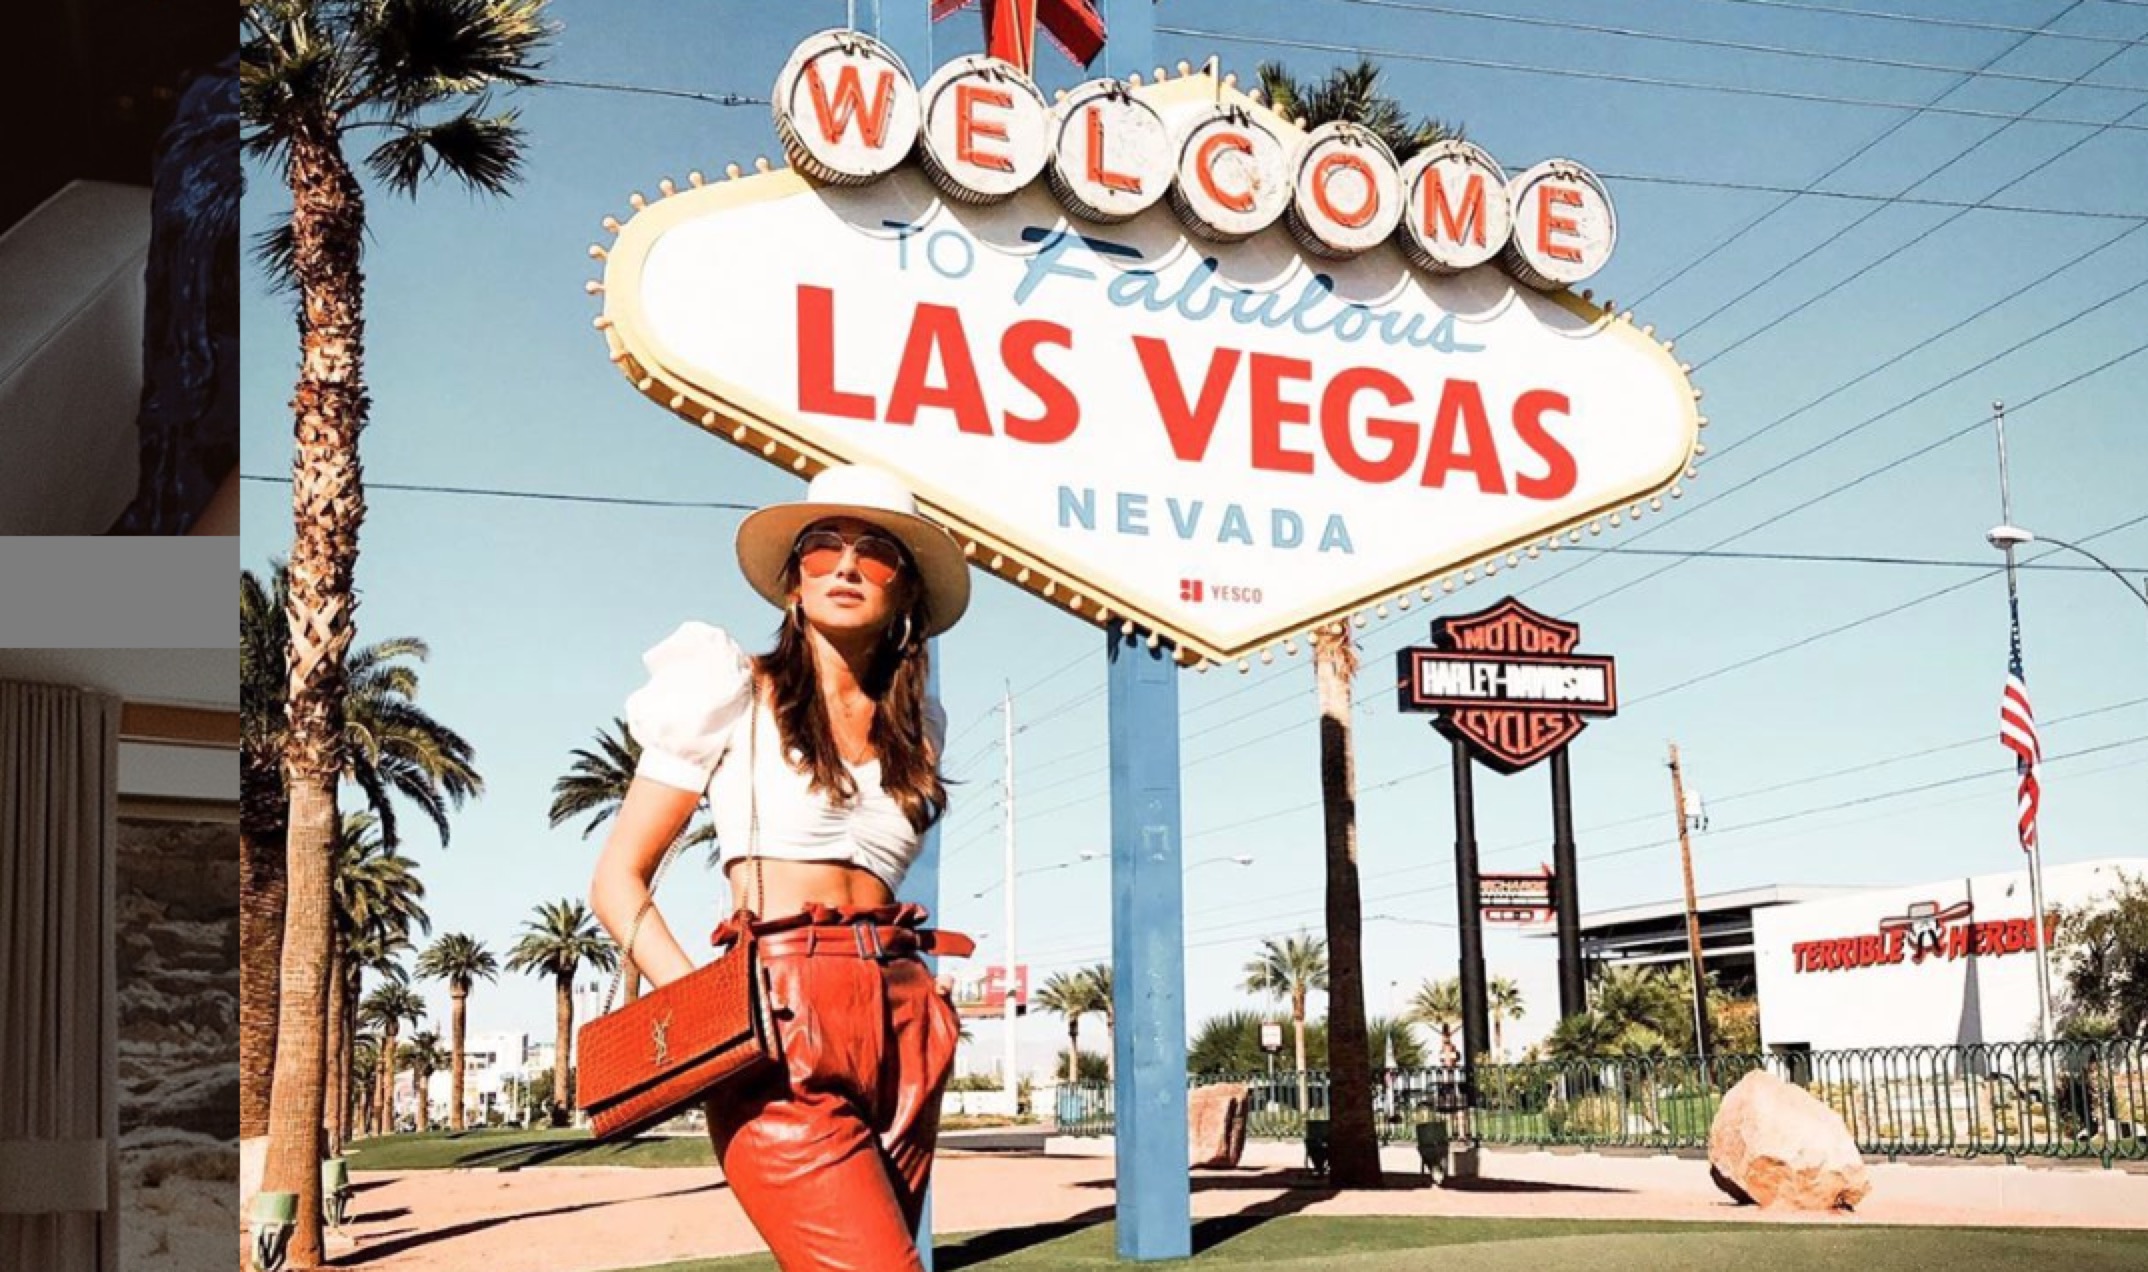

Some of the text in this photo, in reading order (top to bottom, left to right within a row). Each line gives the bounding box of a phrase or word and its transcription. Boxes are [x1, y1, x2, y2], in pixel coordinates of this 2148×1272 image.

[804, 60, 1584, 263] WELCOME
[882, 218, 1487, 353] TO Fabulous
[797, 283, 1579, 501] LAS VEGAS
[1057, 485, 1355, 555] NEVADA
[1211, 585, 1262, 604] YESCO
[1462, 612, 1562, 653] MOTOR
[1466, 709, 1565, 755] CYCLES
[1792, 928, 1904, 973] TERRIBLE
